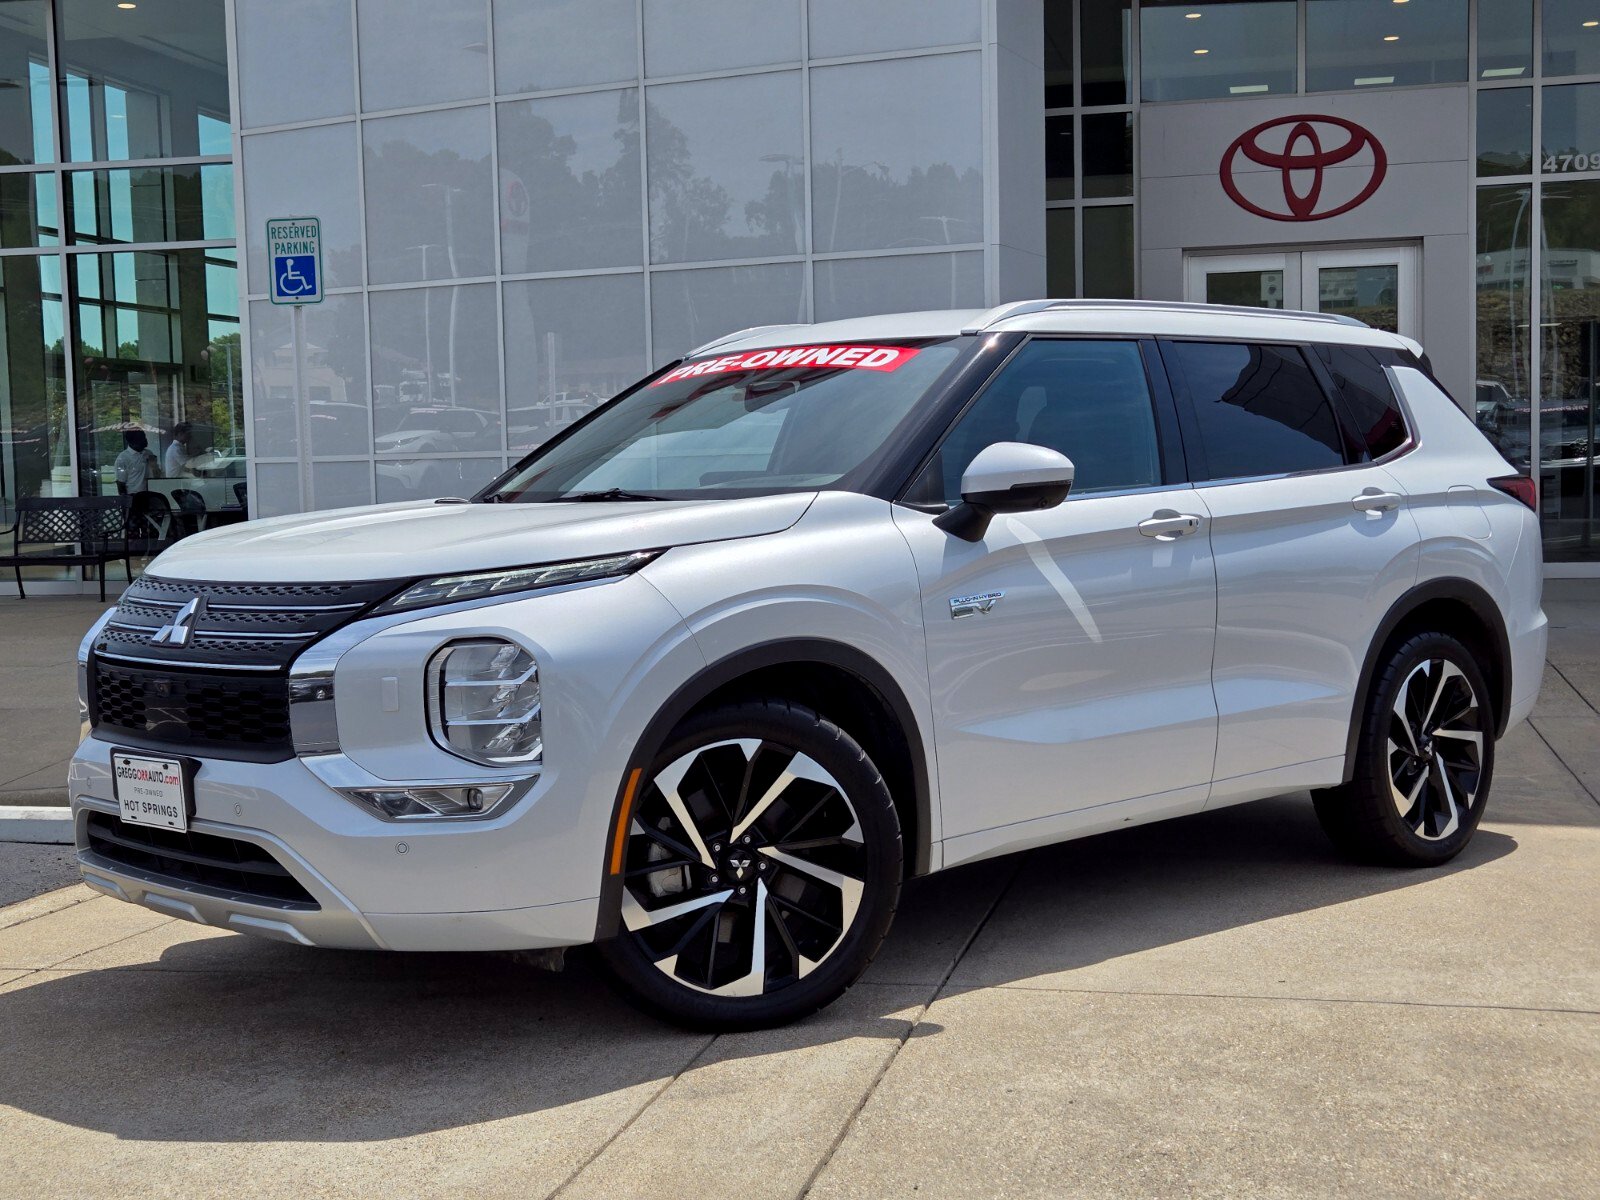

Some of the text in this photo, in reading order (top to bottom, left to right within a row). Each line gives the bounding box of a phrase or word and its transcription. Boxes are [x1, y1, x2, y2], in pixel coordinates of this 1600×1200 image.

[1542, 154, 1600, 172] 4709
[271, 225, 317, 239] RESERVED
[275, 241, 315, 254] PARKING
[657, 347, 900, 385] PRE-OWNED
[117, 766, 180, 785] GREGGORRAUTO.com
[124, 799, 178, 818] HOT SPRINGS
